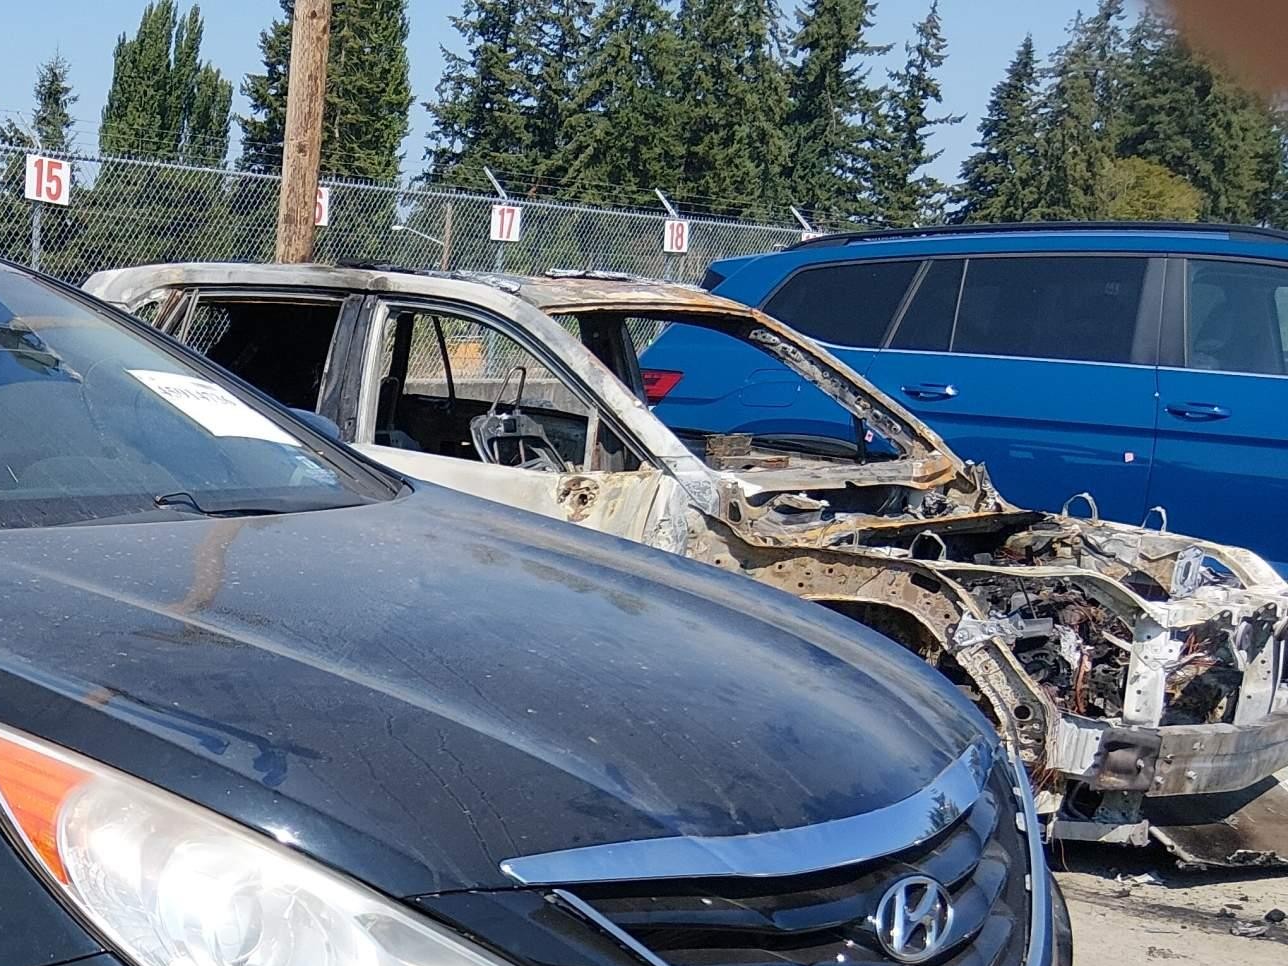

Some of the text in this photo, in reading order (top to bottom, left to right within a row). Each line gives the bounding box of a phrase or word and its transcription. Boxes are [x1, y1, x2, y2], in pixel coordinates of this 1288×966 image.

[33, 158, 63, 201] 15
[497, 208, 515, 239] 17
[669, 223, 685, 251] 18
